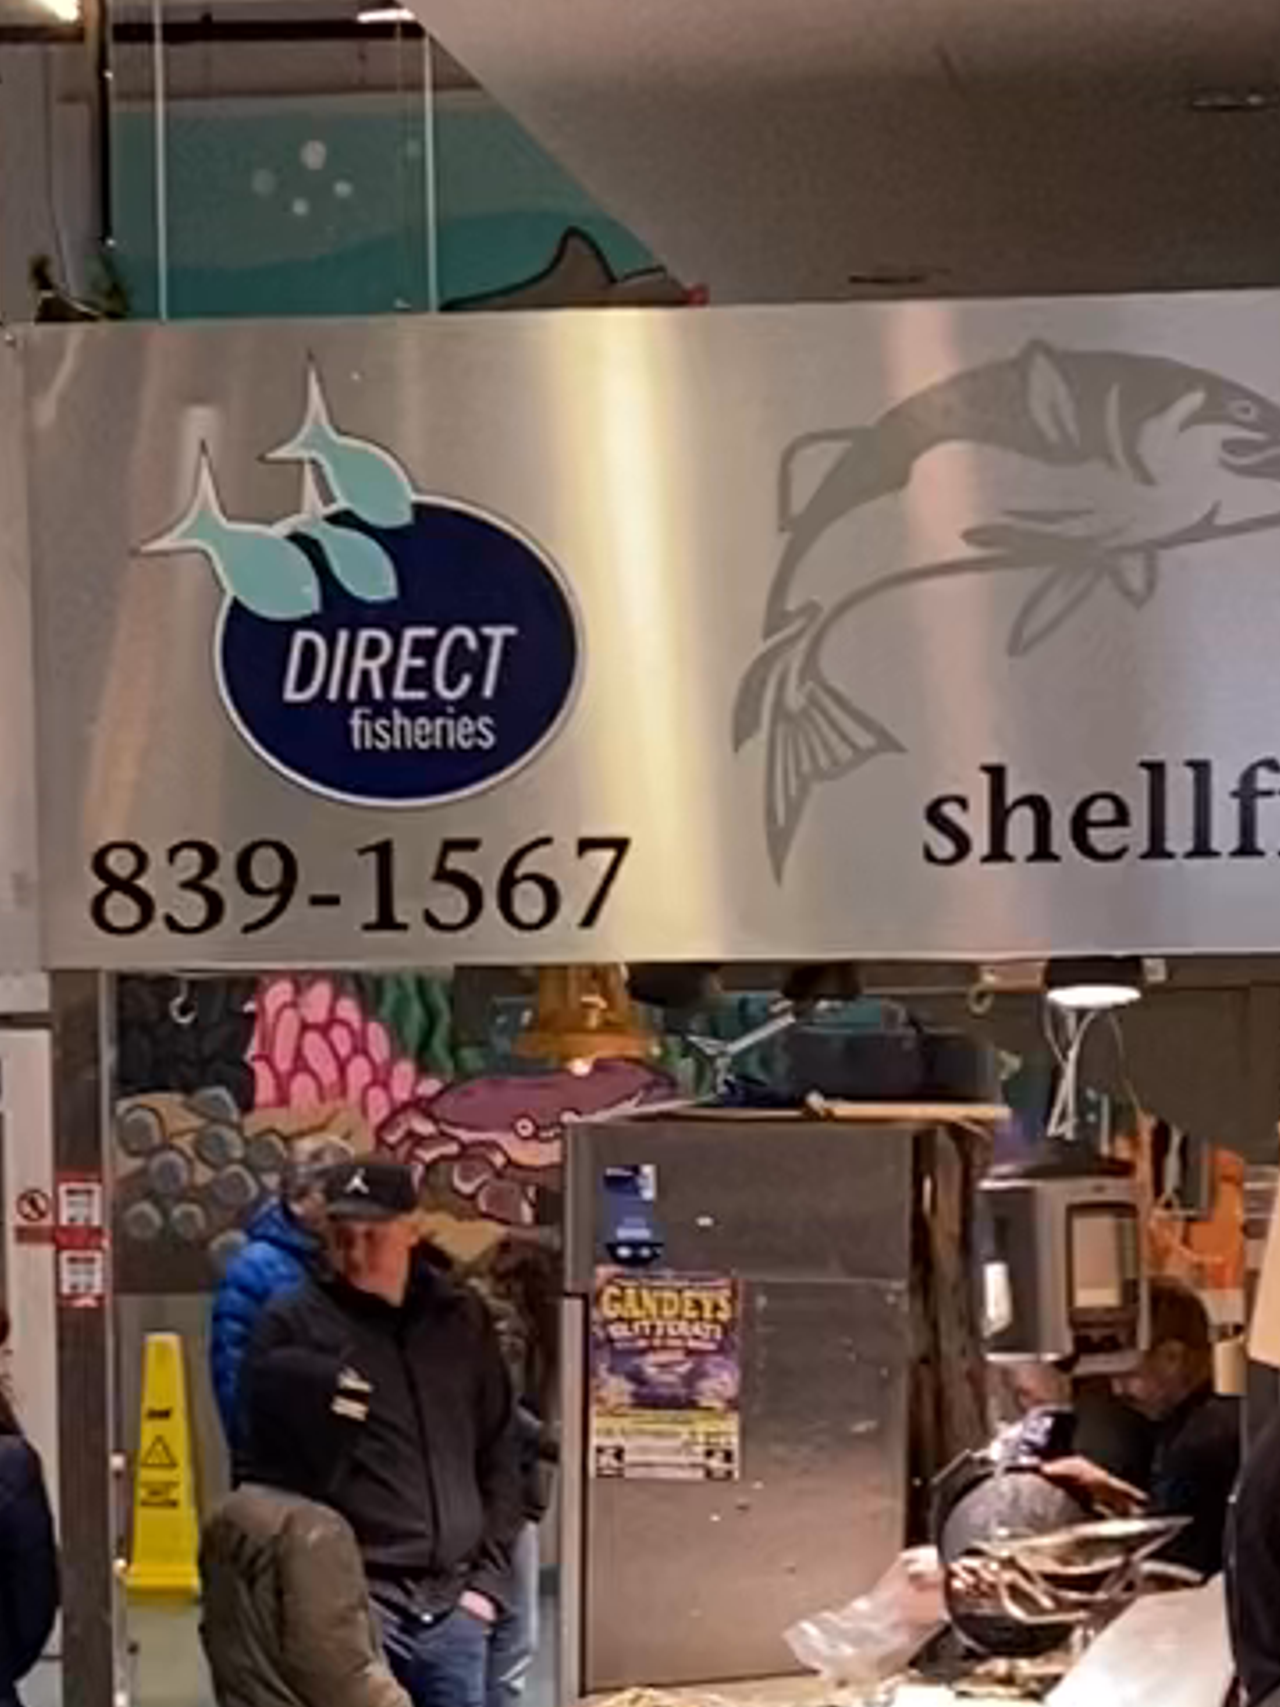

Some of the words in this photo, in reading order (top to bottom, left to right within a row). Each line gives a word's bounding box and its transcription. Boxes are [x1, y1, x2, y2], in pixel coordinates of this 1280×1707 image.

[282, 625, 518, 702] DIRECT
[349, 707, 496, 751] fisheries
[89, 835, 631, 937] 839-1567
[601, 1285, 733, 1321] GANDEYS
